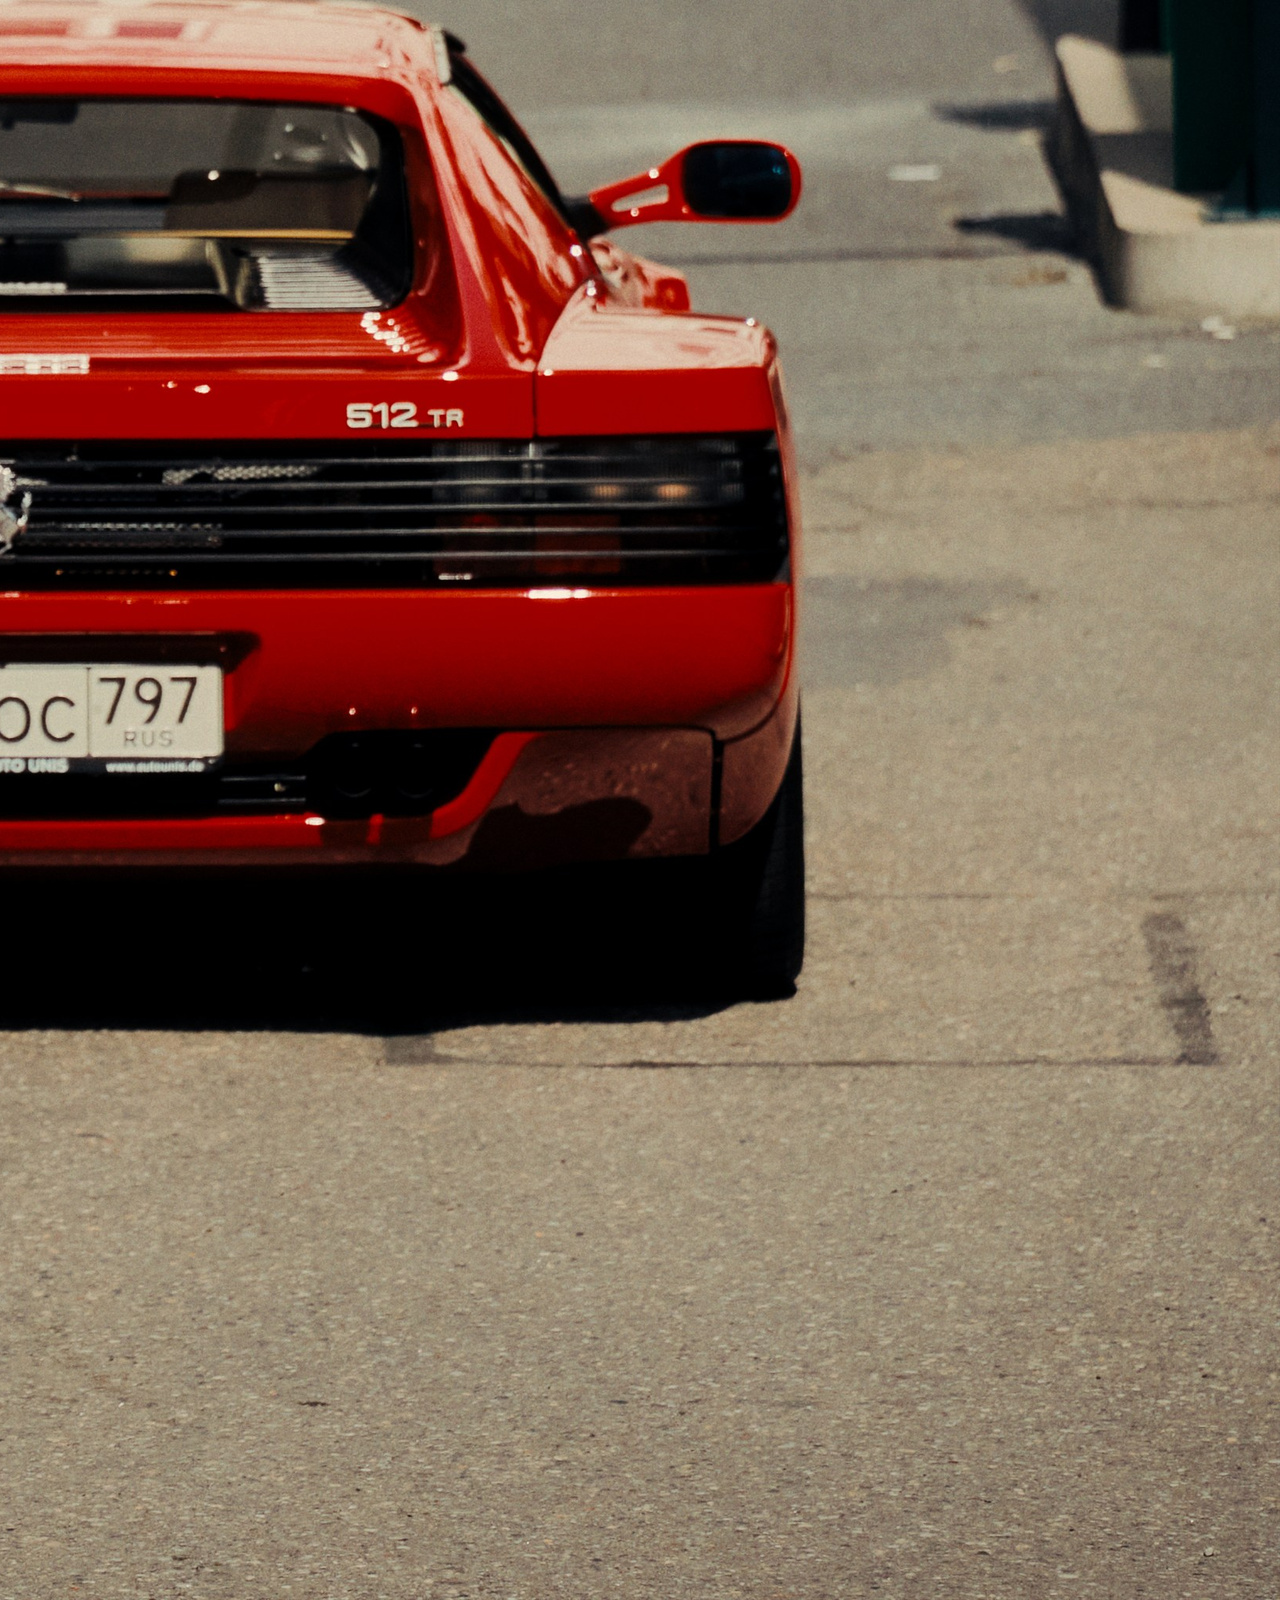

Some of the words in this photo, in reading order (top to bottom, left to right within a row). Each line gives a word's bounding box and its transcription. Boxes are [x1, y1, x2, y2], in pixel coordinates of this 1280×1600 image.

[346, 401, 419, 429] 512
[427, 408, 464, 428] TR
[99, 676, 198, 725] 797
[123, 730, 174, 748] RUS
[27, 758, 70, 774] UNIS
